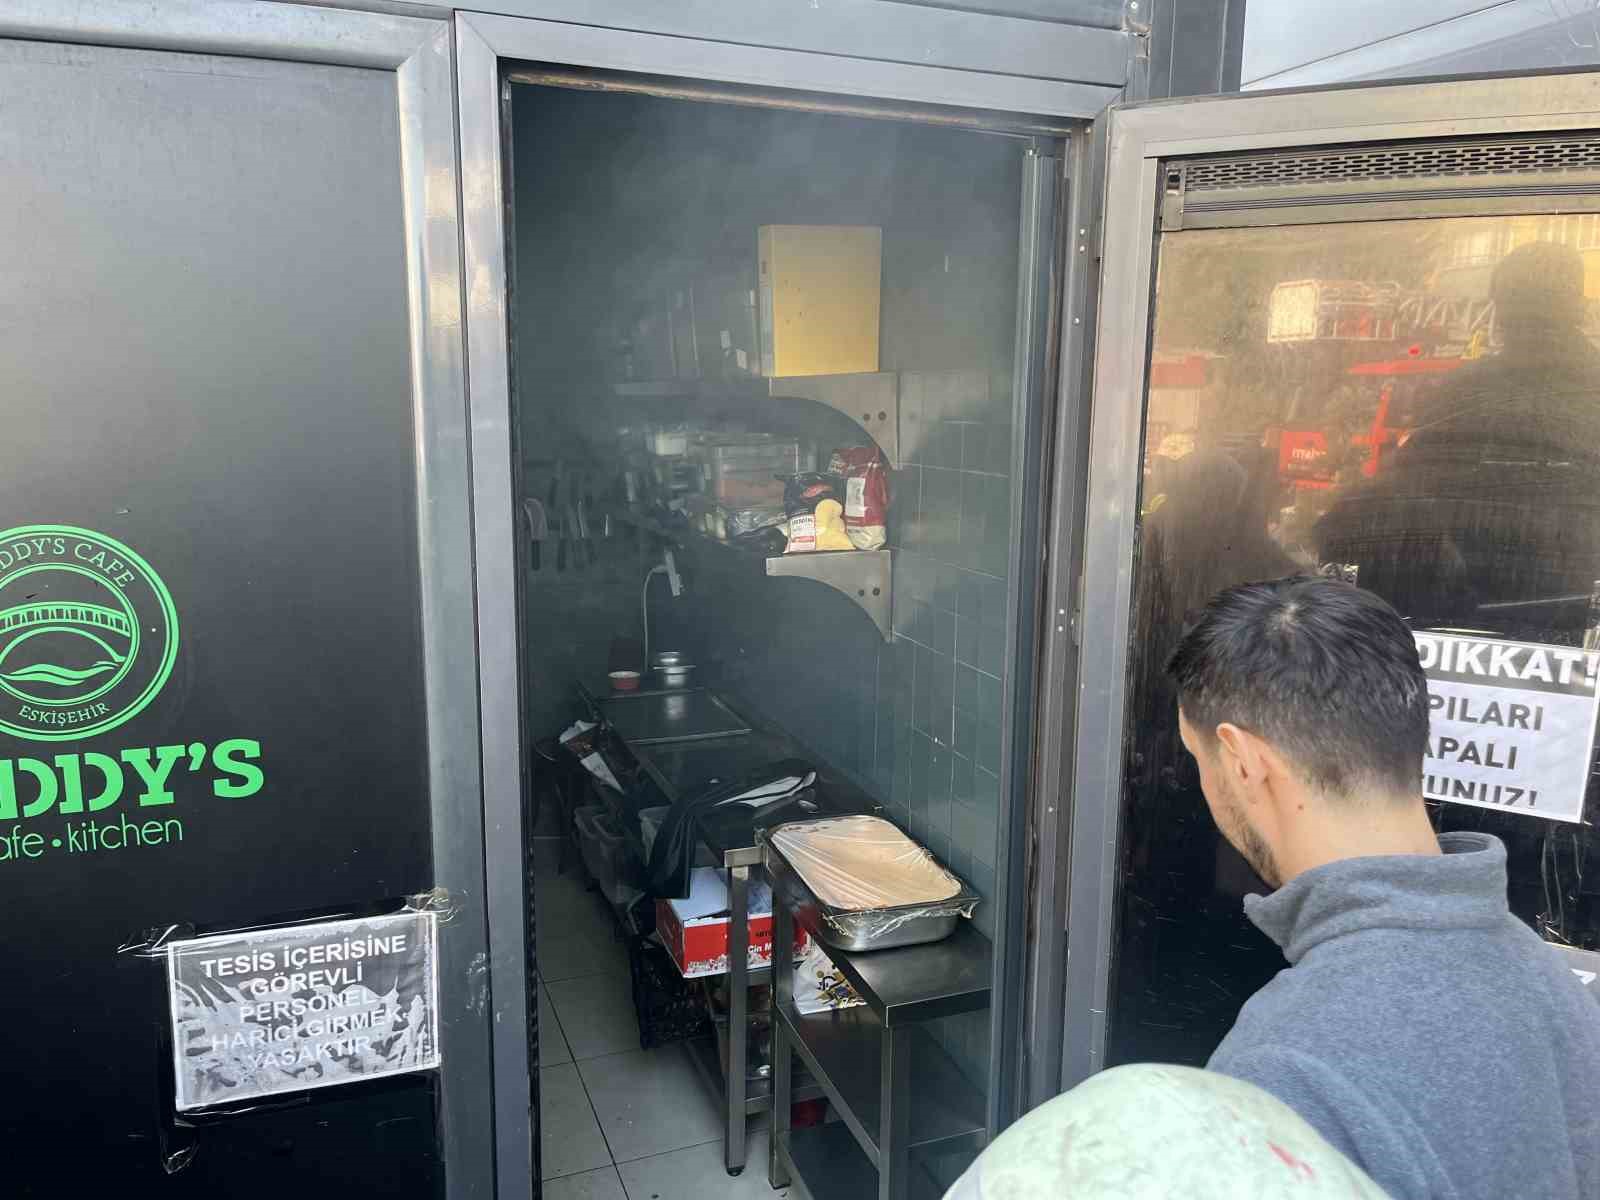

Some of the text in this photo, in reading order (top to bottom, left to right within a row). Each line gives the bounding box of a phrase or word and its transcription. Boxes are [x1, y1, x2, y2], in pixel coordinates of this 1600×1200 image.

[74, 543, 135, 588] CAFE
[19, 702, 110, 726] ESKİŞEHİR
[67, 813, 183, 853] kitchen
[200, 935, 406, 977] TESİS İÇERİSİNE
[250, 961, 362, 996] GÖREVLİ
